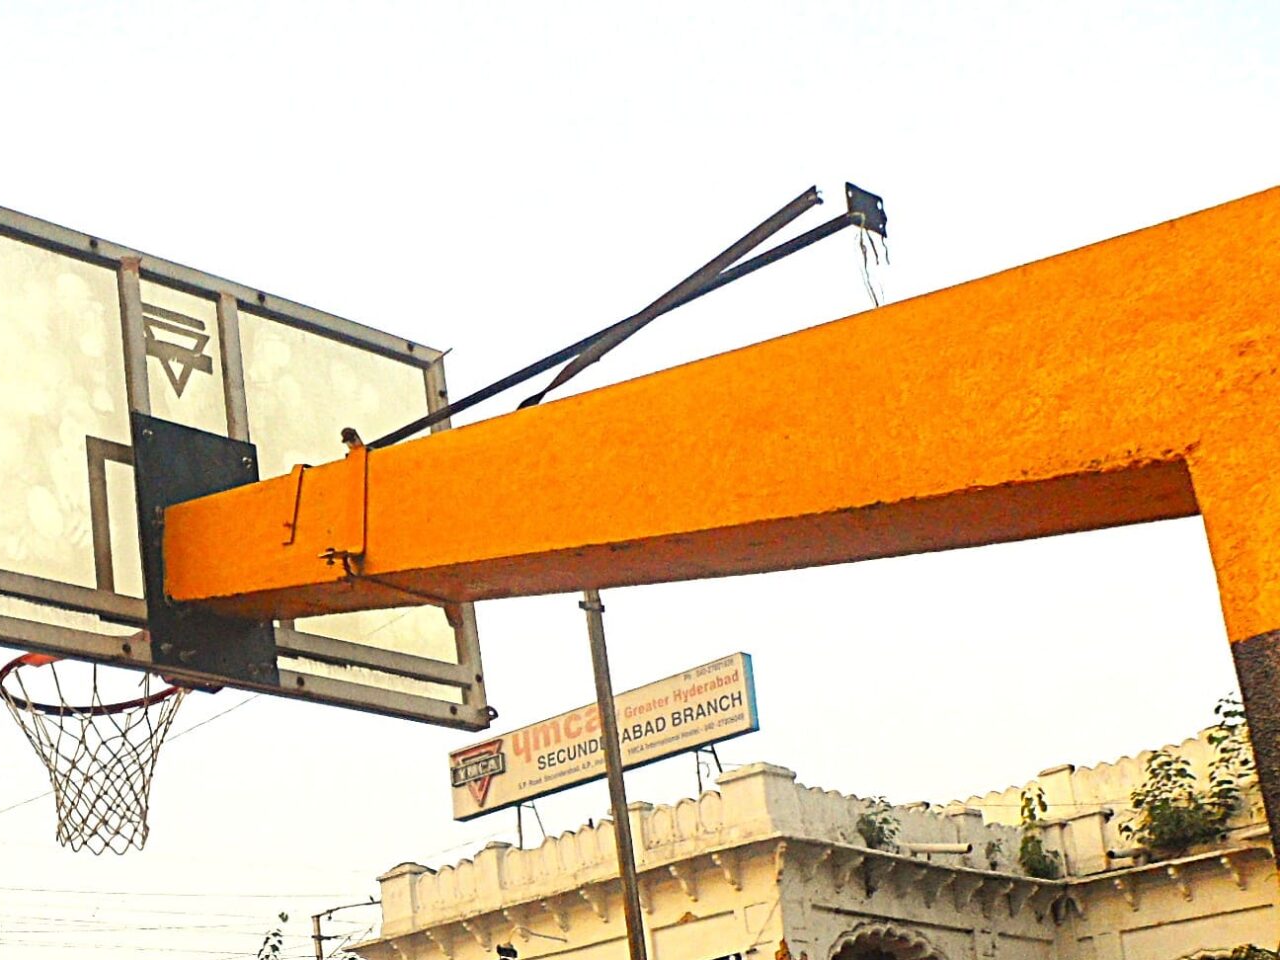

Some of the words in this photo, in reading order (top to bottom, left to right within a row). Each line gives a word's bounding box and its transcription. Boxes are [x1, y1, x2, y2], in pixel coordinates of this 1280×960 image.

[624, 696, 669, 719] Greater
[673, 670, 739, 702] Hyderabad
[512, 708, 601, 763] ymca
[537, 716, 666, 770] SECUNDABAD
[672, 690, 743, 727] BRANCH
[458, 757, 500, 780] YMCA
